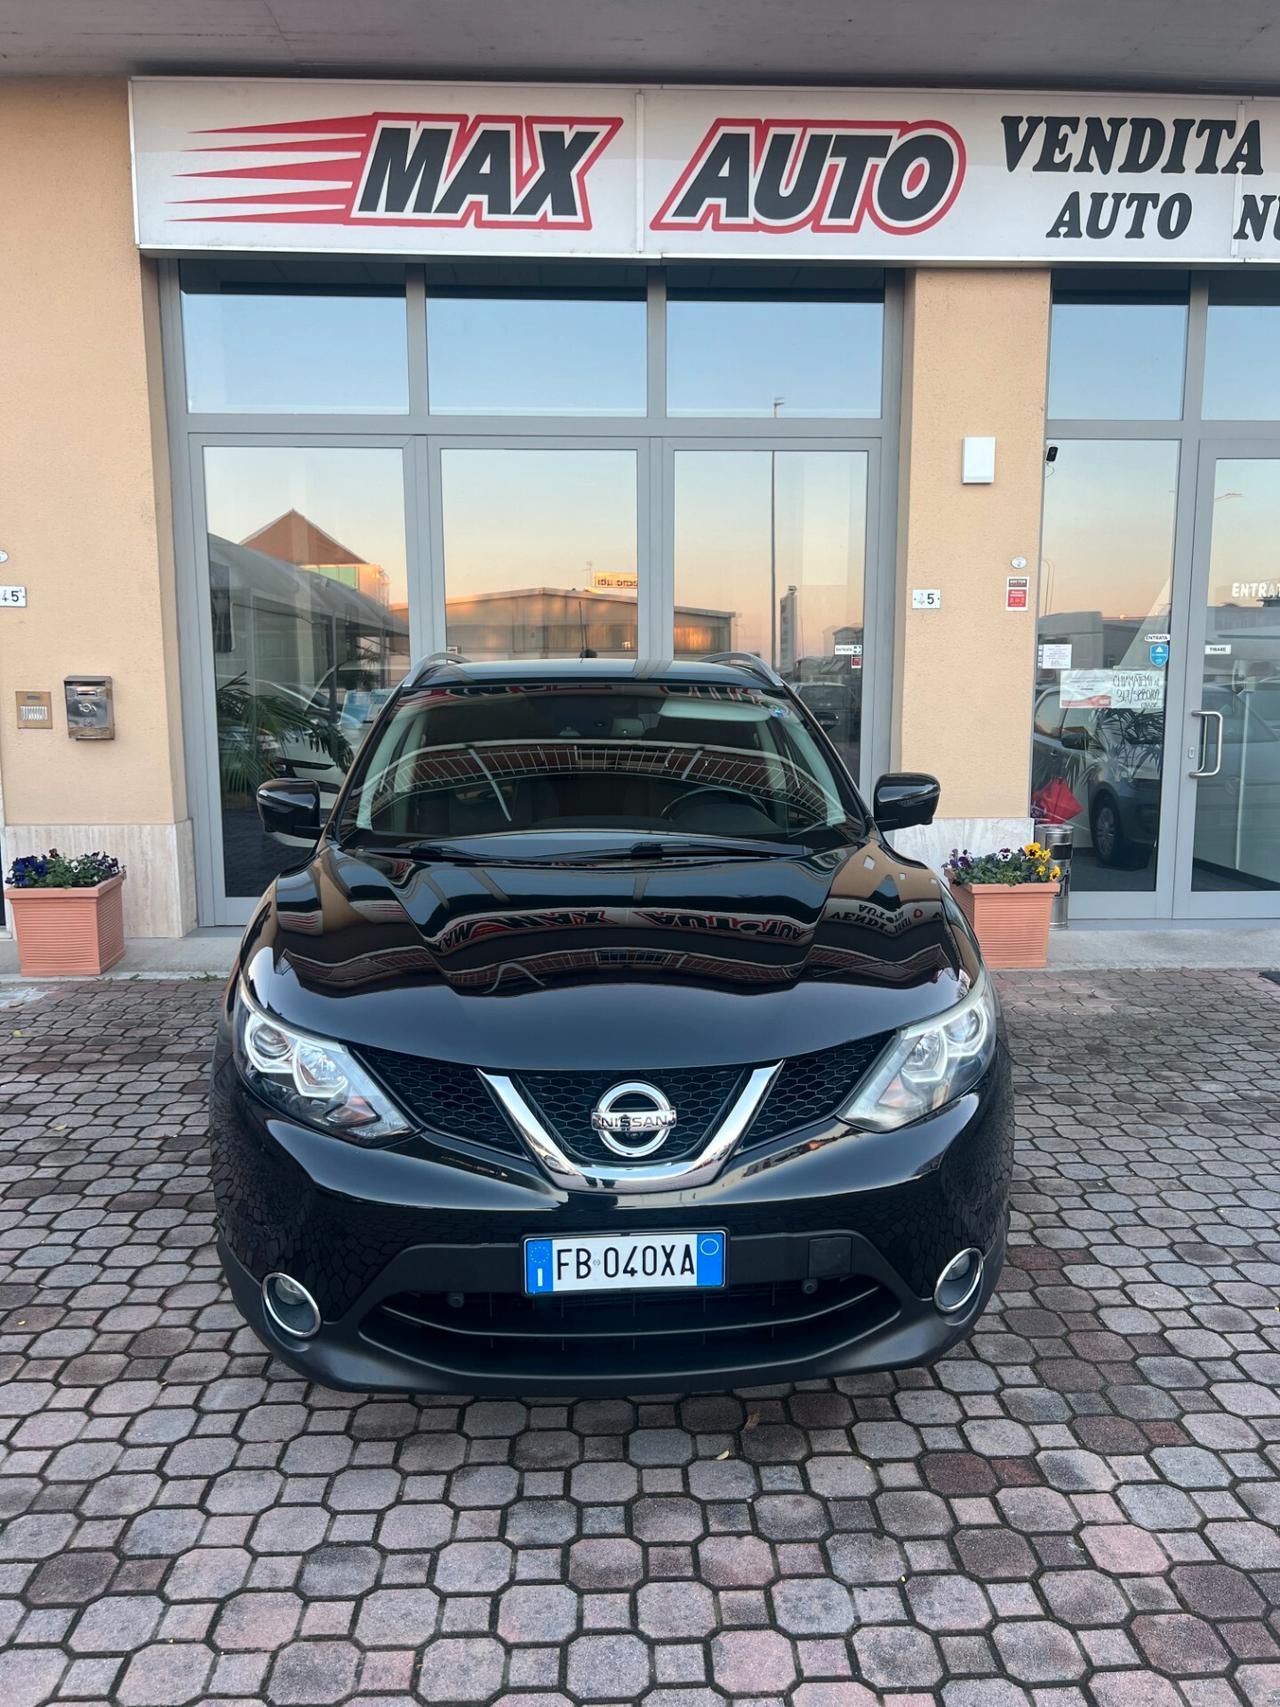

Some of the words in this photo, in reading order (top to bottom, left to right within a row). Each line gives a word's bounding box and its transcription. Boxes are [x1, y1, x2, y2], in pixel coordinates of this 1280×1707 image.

[1000, 115, 1264, 176] VENDITA
[351, 119, 612, 222] MAX
[662, 126, 960, 228] AUTO
[1045, 190, 1193, 240] AUTO
[1232, 194, 1280, 242] N
[601, 1115, 668, 1129] NISSAN
[557, 1247, 592, 1281] FB
[603, 1243, 695, 1278] 040XA
